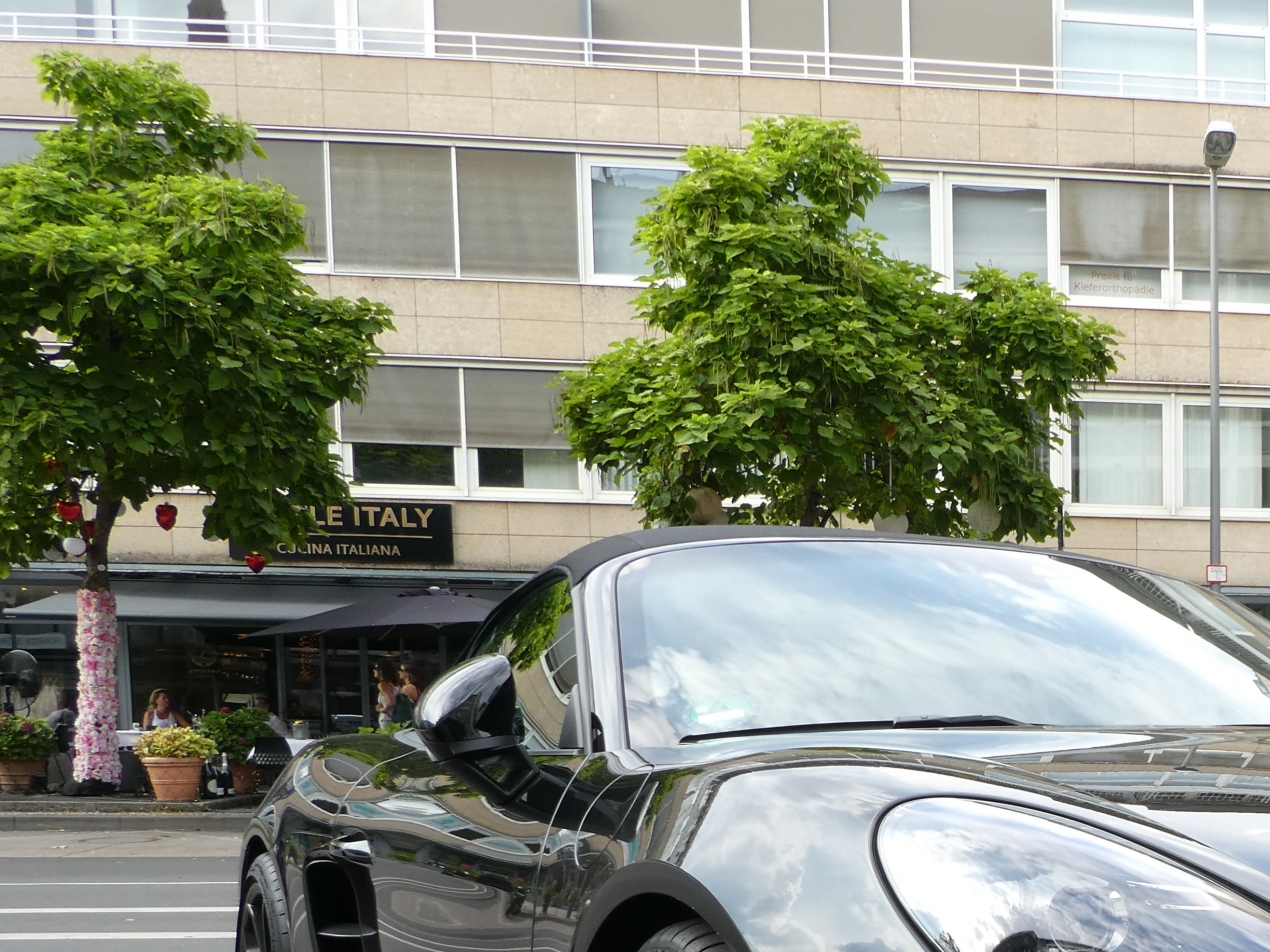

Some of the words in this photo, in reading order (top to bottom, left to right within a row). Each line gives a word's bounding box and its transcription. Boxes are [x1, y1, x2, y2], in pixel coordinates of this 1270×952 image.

[1091, 270, 1120, 281] Praxis
[1073, 281, 1155, 295] Kieferorthopädie
[354, 505, 434, 527] ITALY
[336, 542, 401, 557] ITALIANA
